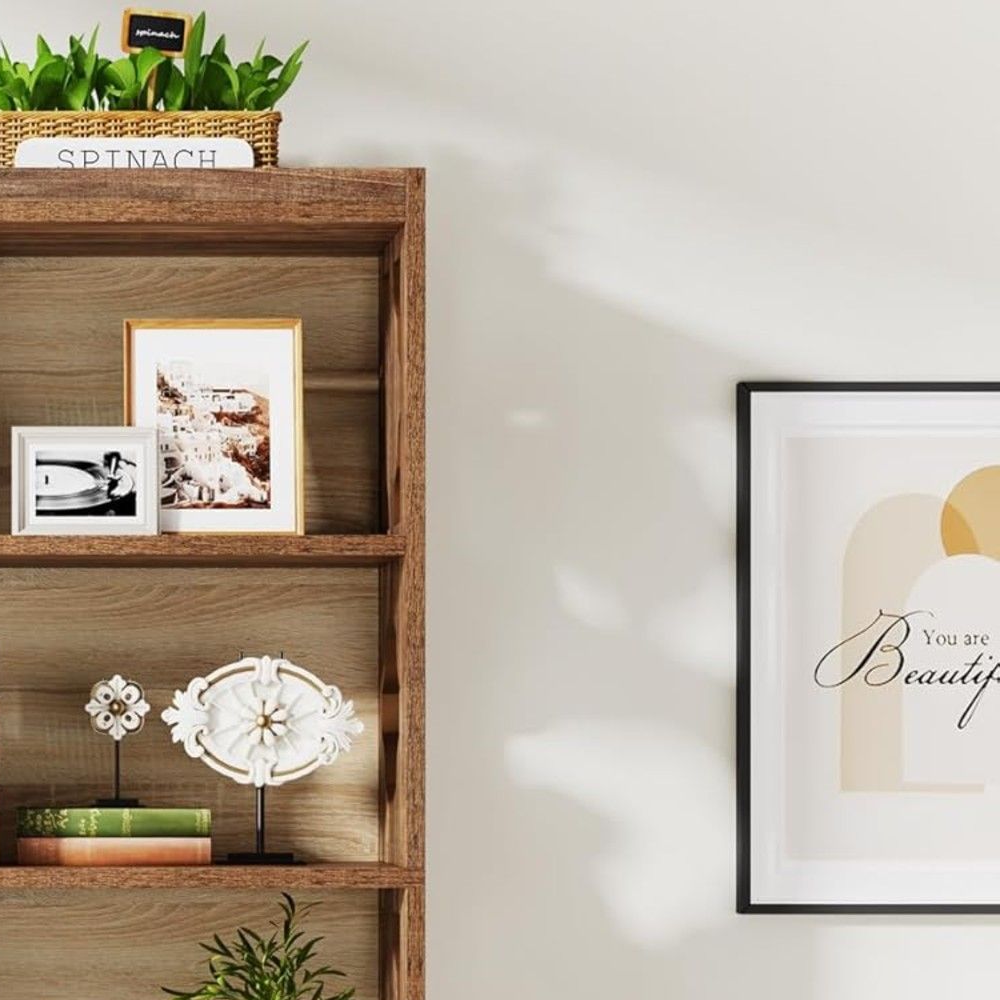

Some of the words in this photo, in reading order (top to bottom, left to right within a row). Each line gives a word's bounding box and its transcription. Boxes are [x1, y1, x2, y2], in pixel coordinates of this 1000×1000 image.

[57, 149, 217, 168] SPINACH
[923, 629, 957, 646] You
[964, 633, 990, 646] are
